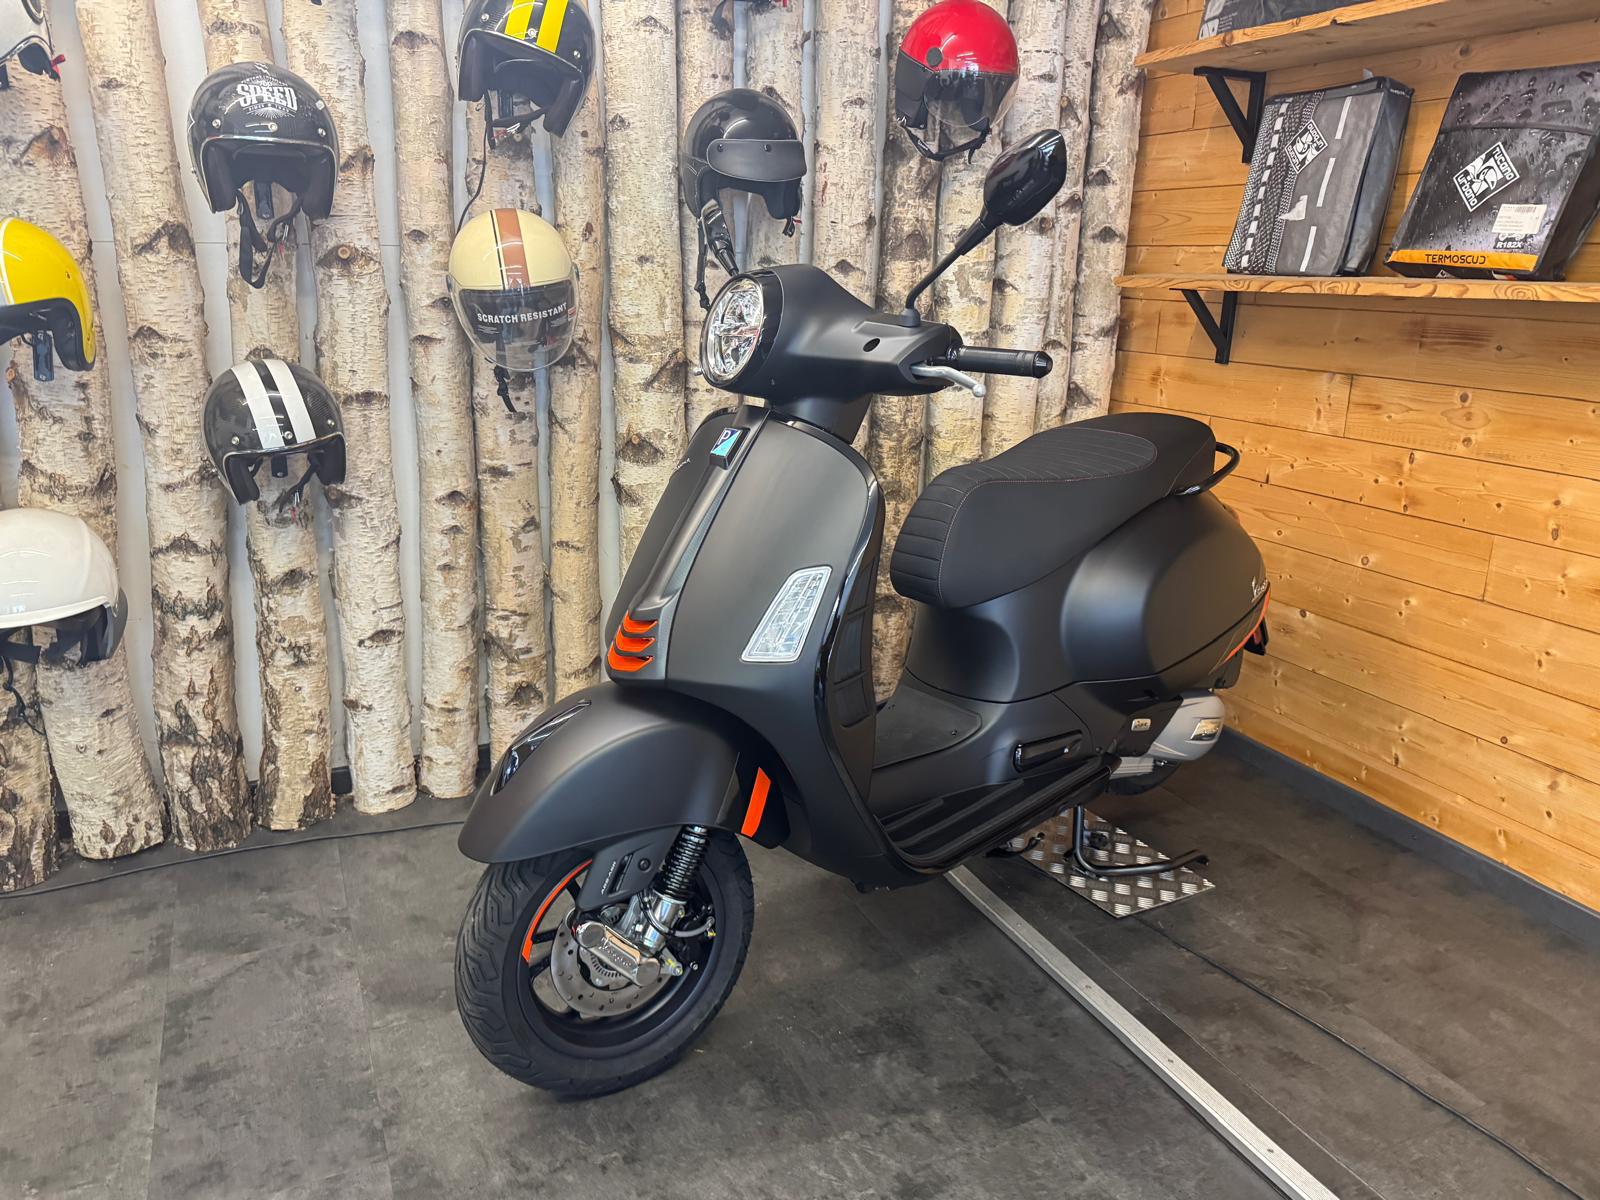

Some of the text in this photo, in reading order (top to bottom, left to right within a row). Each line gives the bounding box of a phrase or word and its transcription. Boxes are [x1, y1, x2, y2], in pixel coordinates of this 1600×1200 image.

[236, 84, 298, 111] SPEED
[1307, 123, 1324, 149] urbano
[1492, 147, 1515, 181] Tucano
[1457, 174, 1478, 207] urbano
[1425, 254, 1487, 265] TERMOSCUD
[477, 313, 519, 324] SCRATCH
[520, 302, 567, 323] RESISTANT
